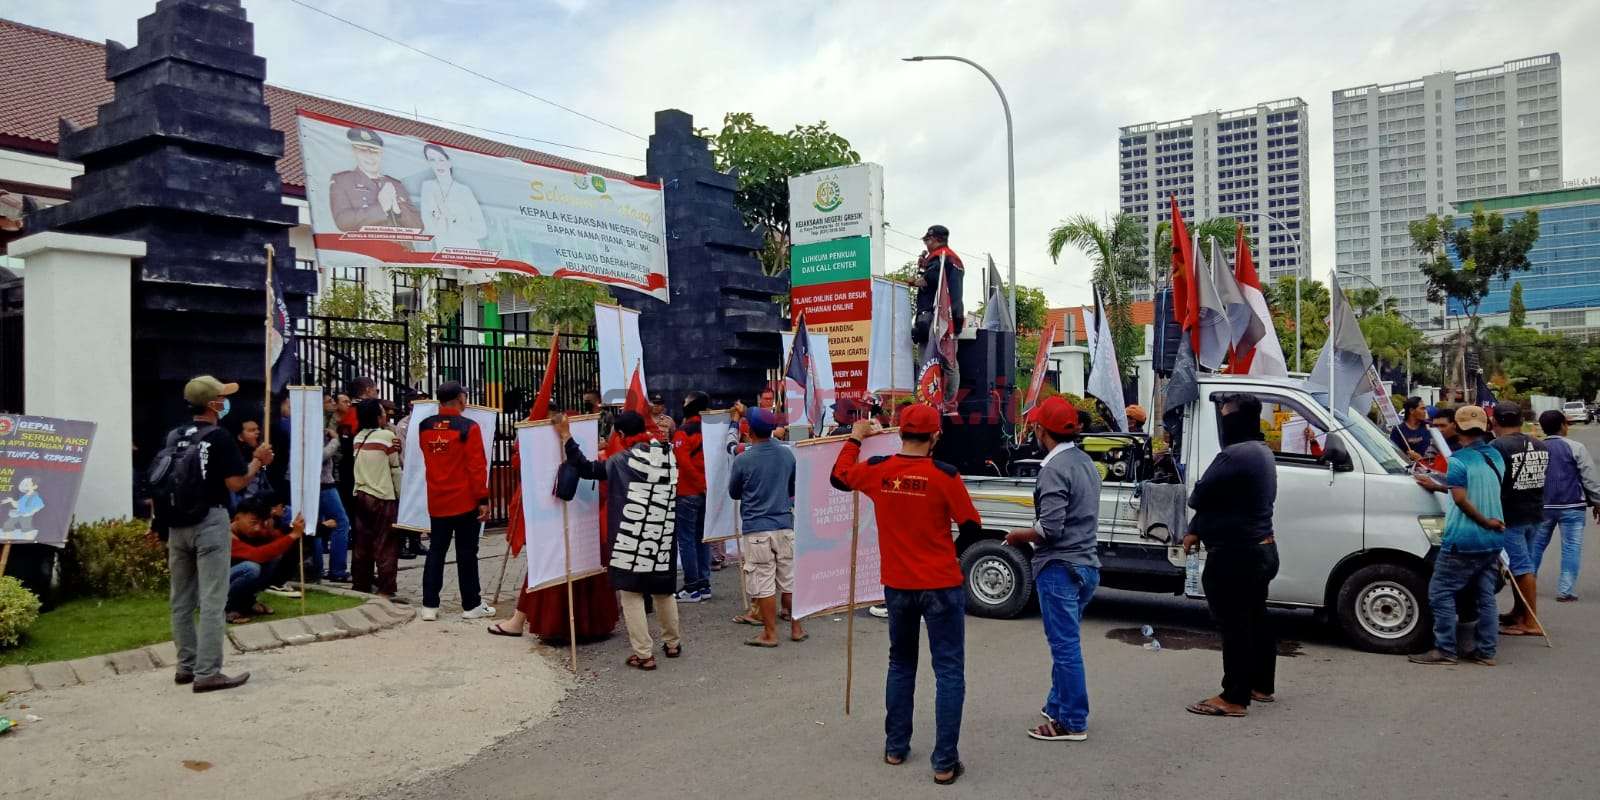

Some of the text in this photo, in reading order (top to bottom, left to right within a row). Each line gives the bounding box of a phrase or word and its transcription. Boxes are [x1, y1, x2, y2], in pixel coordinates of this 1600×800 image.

[520, 206, 558, 220] KEPALA
[560, 213, 608, 230] KEJAKSAN
[609, 222, 638, 236] NEGERI
[795, 217, 824, 228] KEJAKSAAN
[824, 216, 843, 224] NEGERI
[844, 212, 863, 222] GRESIK
[546, 224, 576, 237] BAPAK
[577, 230, 600, 241] NANA
[555, 248, 584, 259] KETUA
[600, 255, 629, 268] DAERAH
[801, 250, 857, 264] LUHKUM PENKUM
[815, 264, 832, 272] CALL
[832, 261, 857, 270] CENTER
[793, 291, 867, 305] TILANG ONLINE DAN BESUK
[804, 302, 854, 314] TAHANAN ONLINE
[850, 369, 863, 377] DAN
[19, 421, 56, 431] GEPAL
[22, 433, 89, 446] SERUAN AKSI
[27, 441, 65, 450] DENGAN
[609, 481, 652, 571] WOTAN
[633, 484, 672, 573] WARGA
